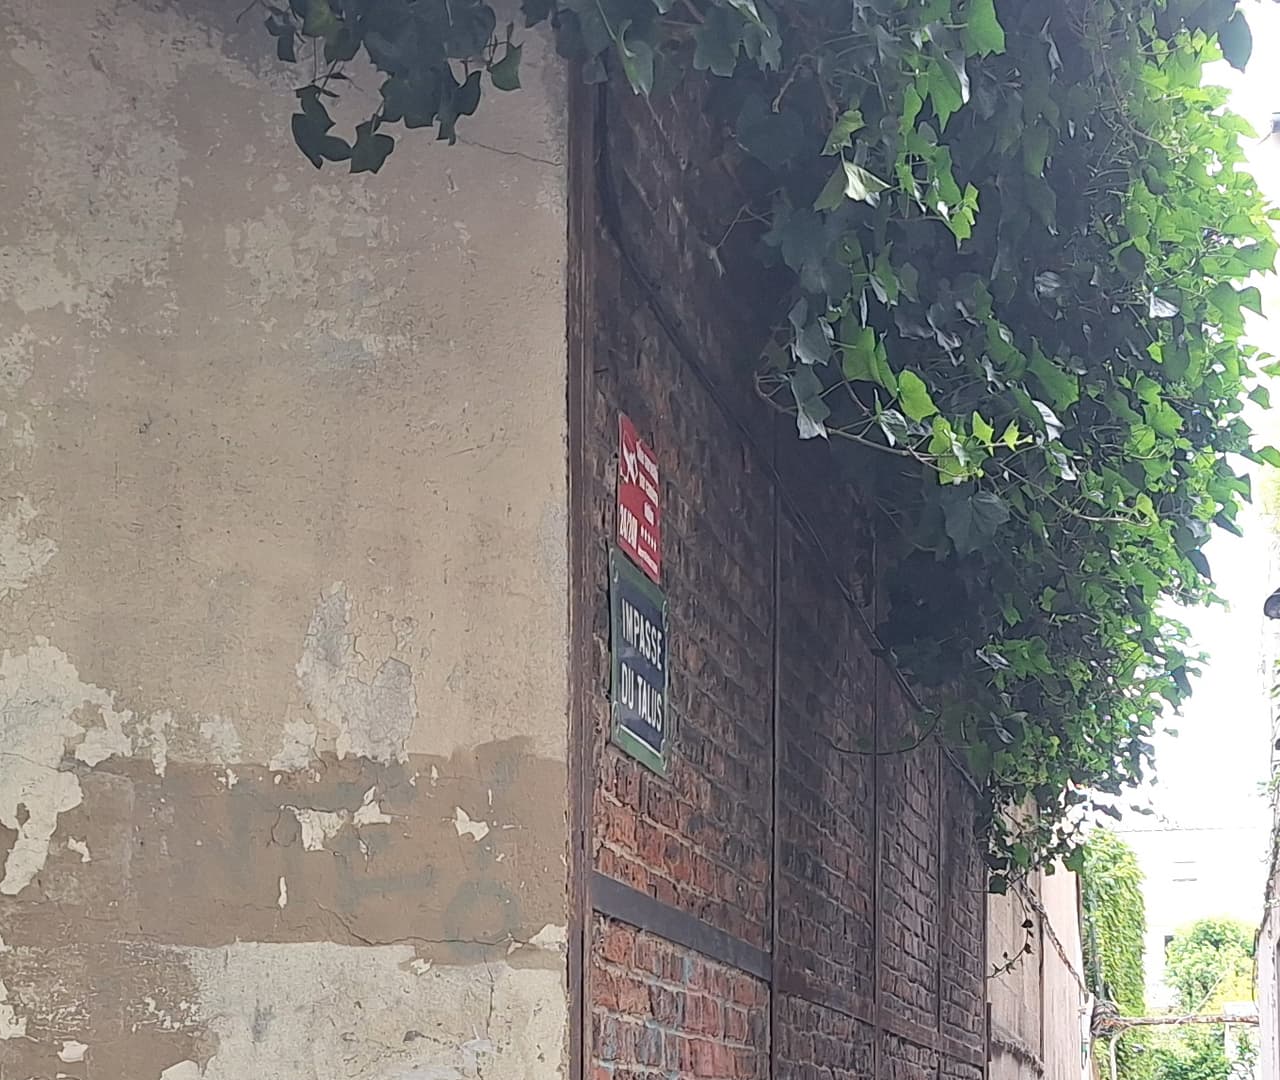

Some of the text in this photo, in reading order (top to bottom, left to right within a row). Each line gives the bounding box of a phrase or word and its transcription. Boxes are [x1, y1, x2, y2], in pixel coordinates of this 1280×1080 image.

[621, 598, 663, 671] IMPASSE
[621, 661, 663, 733] DU TALUS
